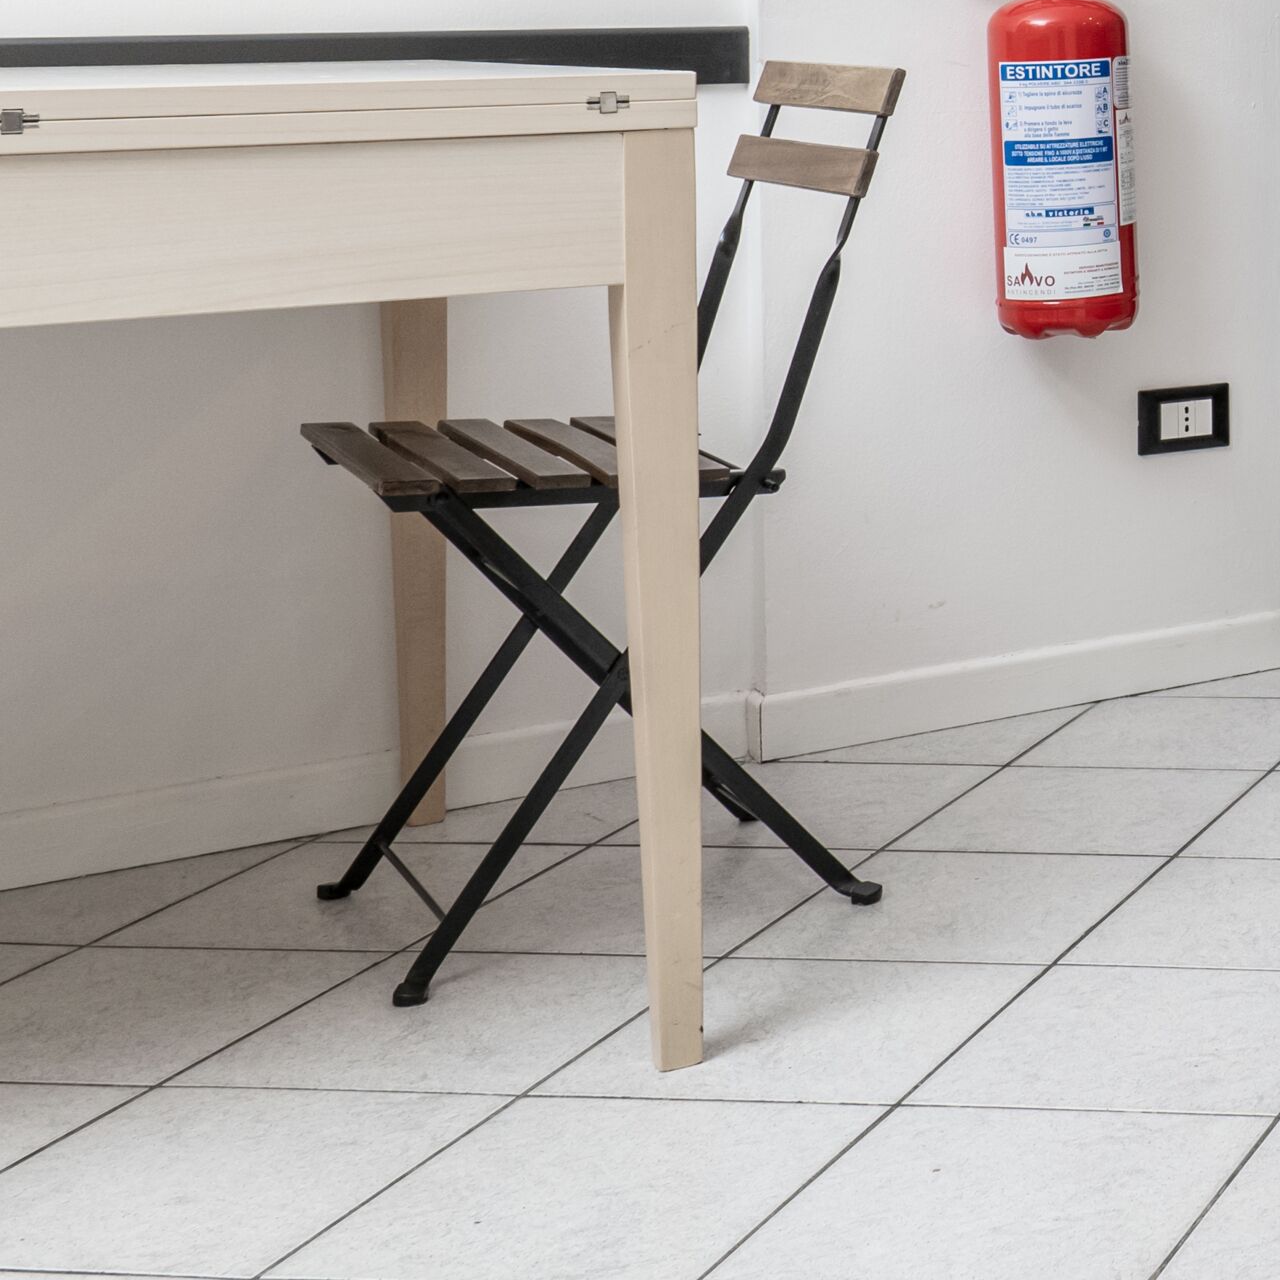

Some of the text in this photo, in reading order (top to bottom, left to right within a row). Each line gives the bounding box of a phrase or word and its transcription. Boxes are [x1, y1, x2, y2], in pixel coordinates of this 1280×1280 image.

[1006, 63, 1101, 79] ESTINTORE
[1102, 86, 1108, 94] A
[1103, 103, 1108, 111] B
[1103, 119, 1109, 127] C
[1048, 208, 1090, 218] victoria
[1009, 233, 1038, 245] CE 0497
